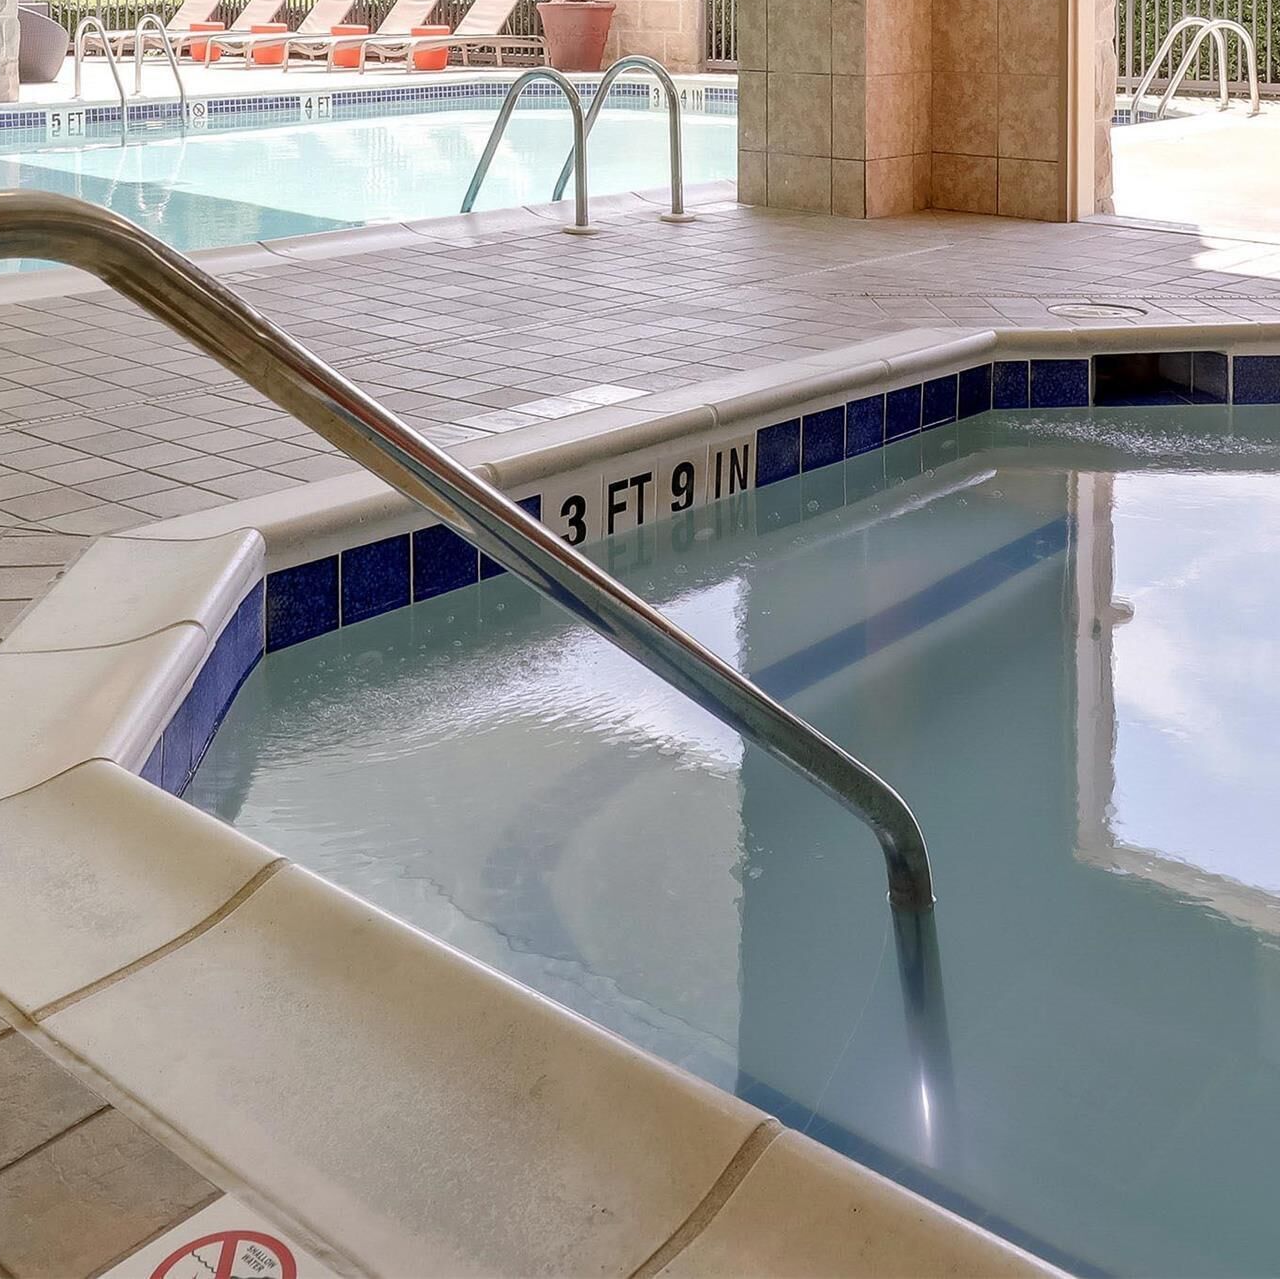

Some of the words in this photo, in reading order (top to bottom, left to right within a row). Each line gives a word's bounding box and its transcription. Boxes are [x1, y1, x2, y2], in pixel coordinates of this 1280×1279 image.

[680, 89, 687, 100] 4
[305, 97, 312, 109] 4
[318, 96, 330, 110] FT
[52, 113, 61, 127] 5
[68, 112, 83, 126] FT
[560, 495, 586, 546] 3
[608, 472, 652, 535] FT
[671, 461, 695, 512] 9
[715, 444, 749, 499] IN
